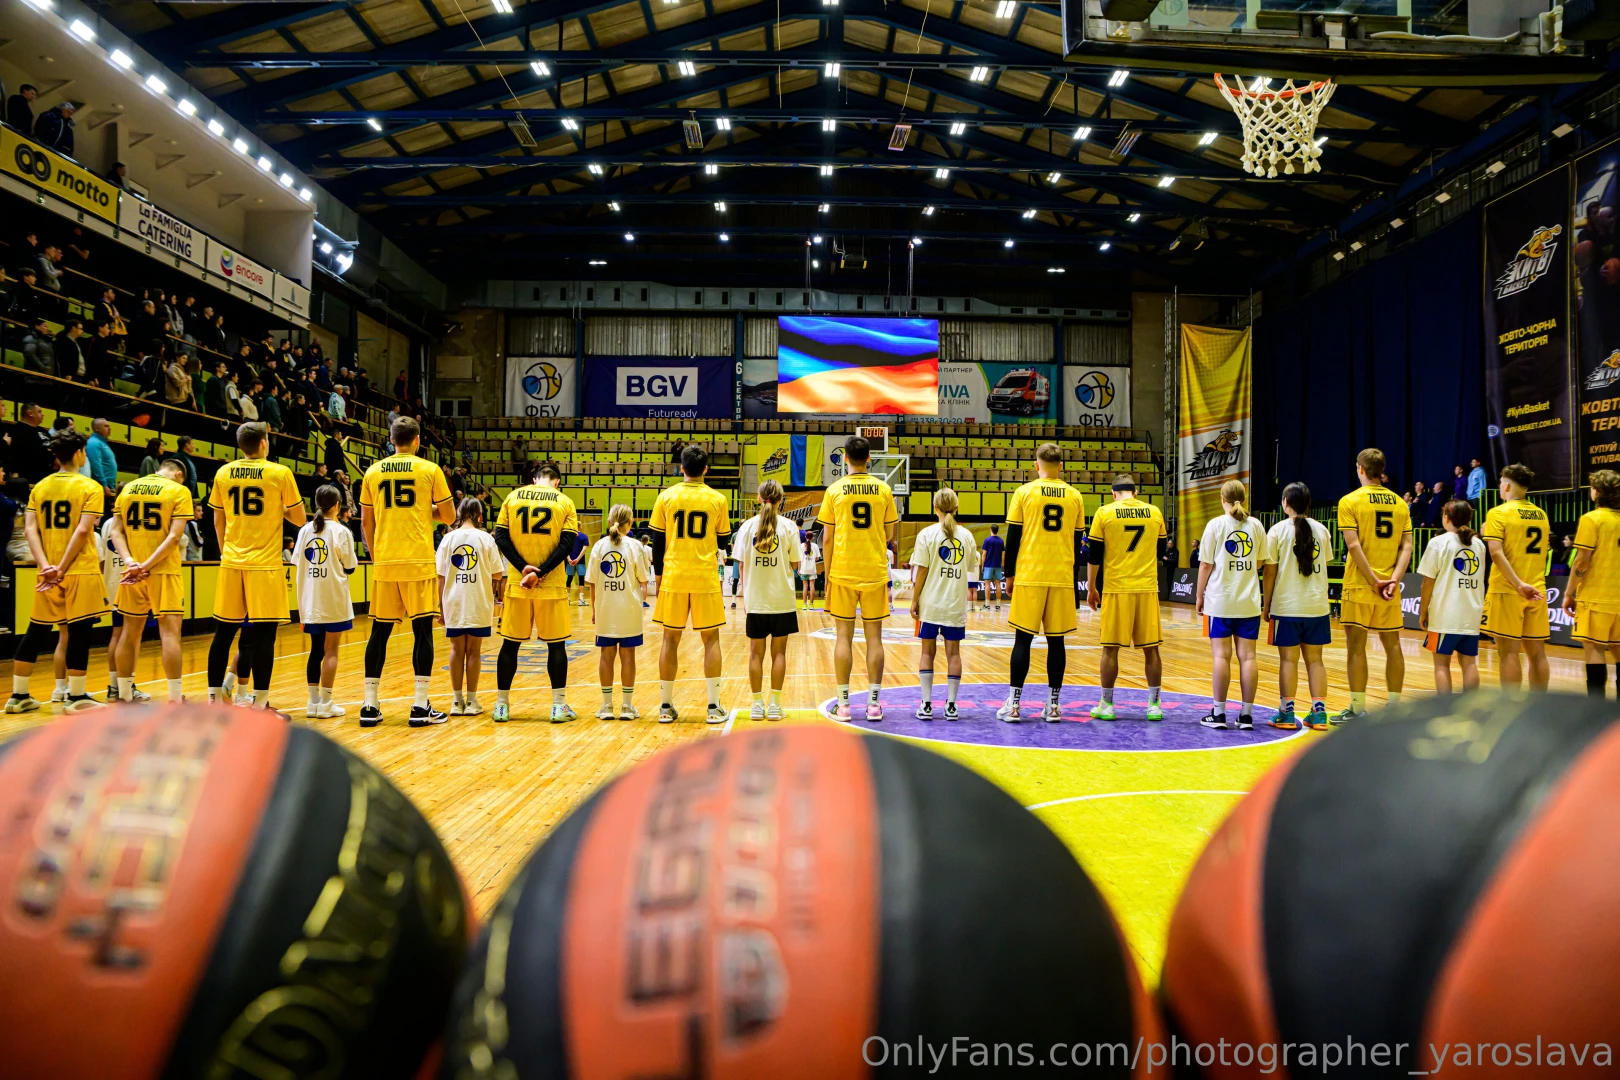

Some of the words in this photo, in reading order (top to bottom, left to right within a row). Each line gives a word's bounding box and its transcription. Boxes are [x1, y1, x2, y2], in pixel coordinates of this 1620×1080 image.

[56, 167, 109, 207] motto
[139, 203, 150, 219] La
[152, 209, 192, 241] FAMIGLIA
[138, 219, 192, 258] CATERING
[236, 264, 263, 285] encore
[1498, 318, 1557, 345] ЖОВТО-ЧОРНА
[1504, 335, 1548, 355] ТЕРИТОРІЯ
[735, 361, 743, 375] 6
[626, 375, 688, 397] BGV
[525, 405, 561, 418] ФБУ
[1506, 401, 1550, 418] #KyivBasket
[1581, 397, 1620, 416] ЖОВТ
[648, 409, 698, 419] Futuready
[1079, 413, 1114, 427] ФБУ
[1589, 441, 1618, 454] КУПУЙ
[229, 467, 264, 480] KARPIUK
[381, 461, 413, 473] SANDUL
[378, 479, 416, 509] 15
[517, 490, 559, 502] KLEVZUNIK
[842, 483, 879, 496] SMITIUKH
[1041, 486, 1066, 499] KOHUT
[228, 485, 265, 516] 16
[589, 498, 595, 506] 6
[1367, 493, 1397, 505] ZAITSEV
[40, 500, 71, 530] 18
[126, 501, 162, 531] 45
[851, 501, 871, 530] 9
[1042, 504, 1064, 532] 8
[1116, 507, 1151, 519] BURENKO
[516, 506, 551, 535] 12
[673, 509, 709, 539] 10
[1374, 510, 1394, 539] 5
[1124, 524, 1145, 553] 7
[1525, 526, 1543, 554] 2
[112, 558, 124, 567] FB
[755, 556, 778, 567] FBU
[1229, 560, 1252, 571] FBU
[308, 567, 328, 578] FBU
[455, 573, 477, 584] FBU
[940, 567, 962, 580] FBU
[604, 580, 626, 592] FBU
[1172, 581, 1194, 595] SPALDING
[1458, 578, 1478, 589] FBU
[1480, 615, 1488, 625] 2
